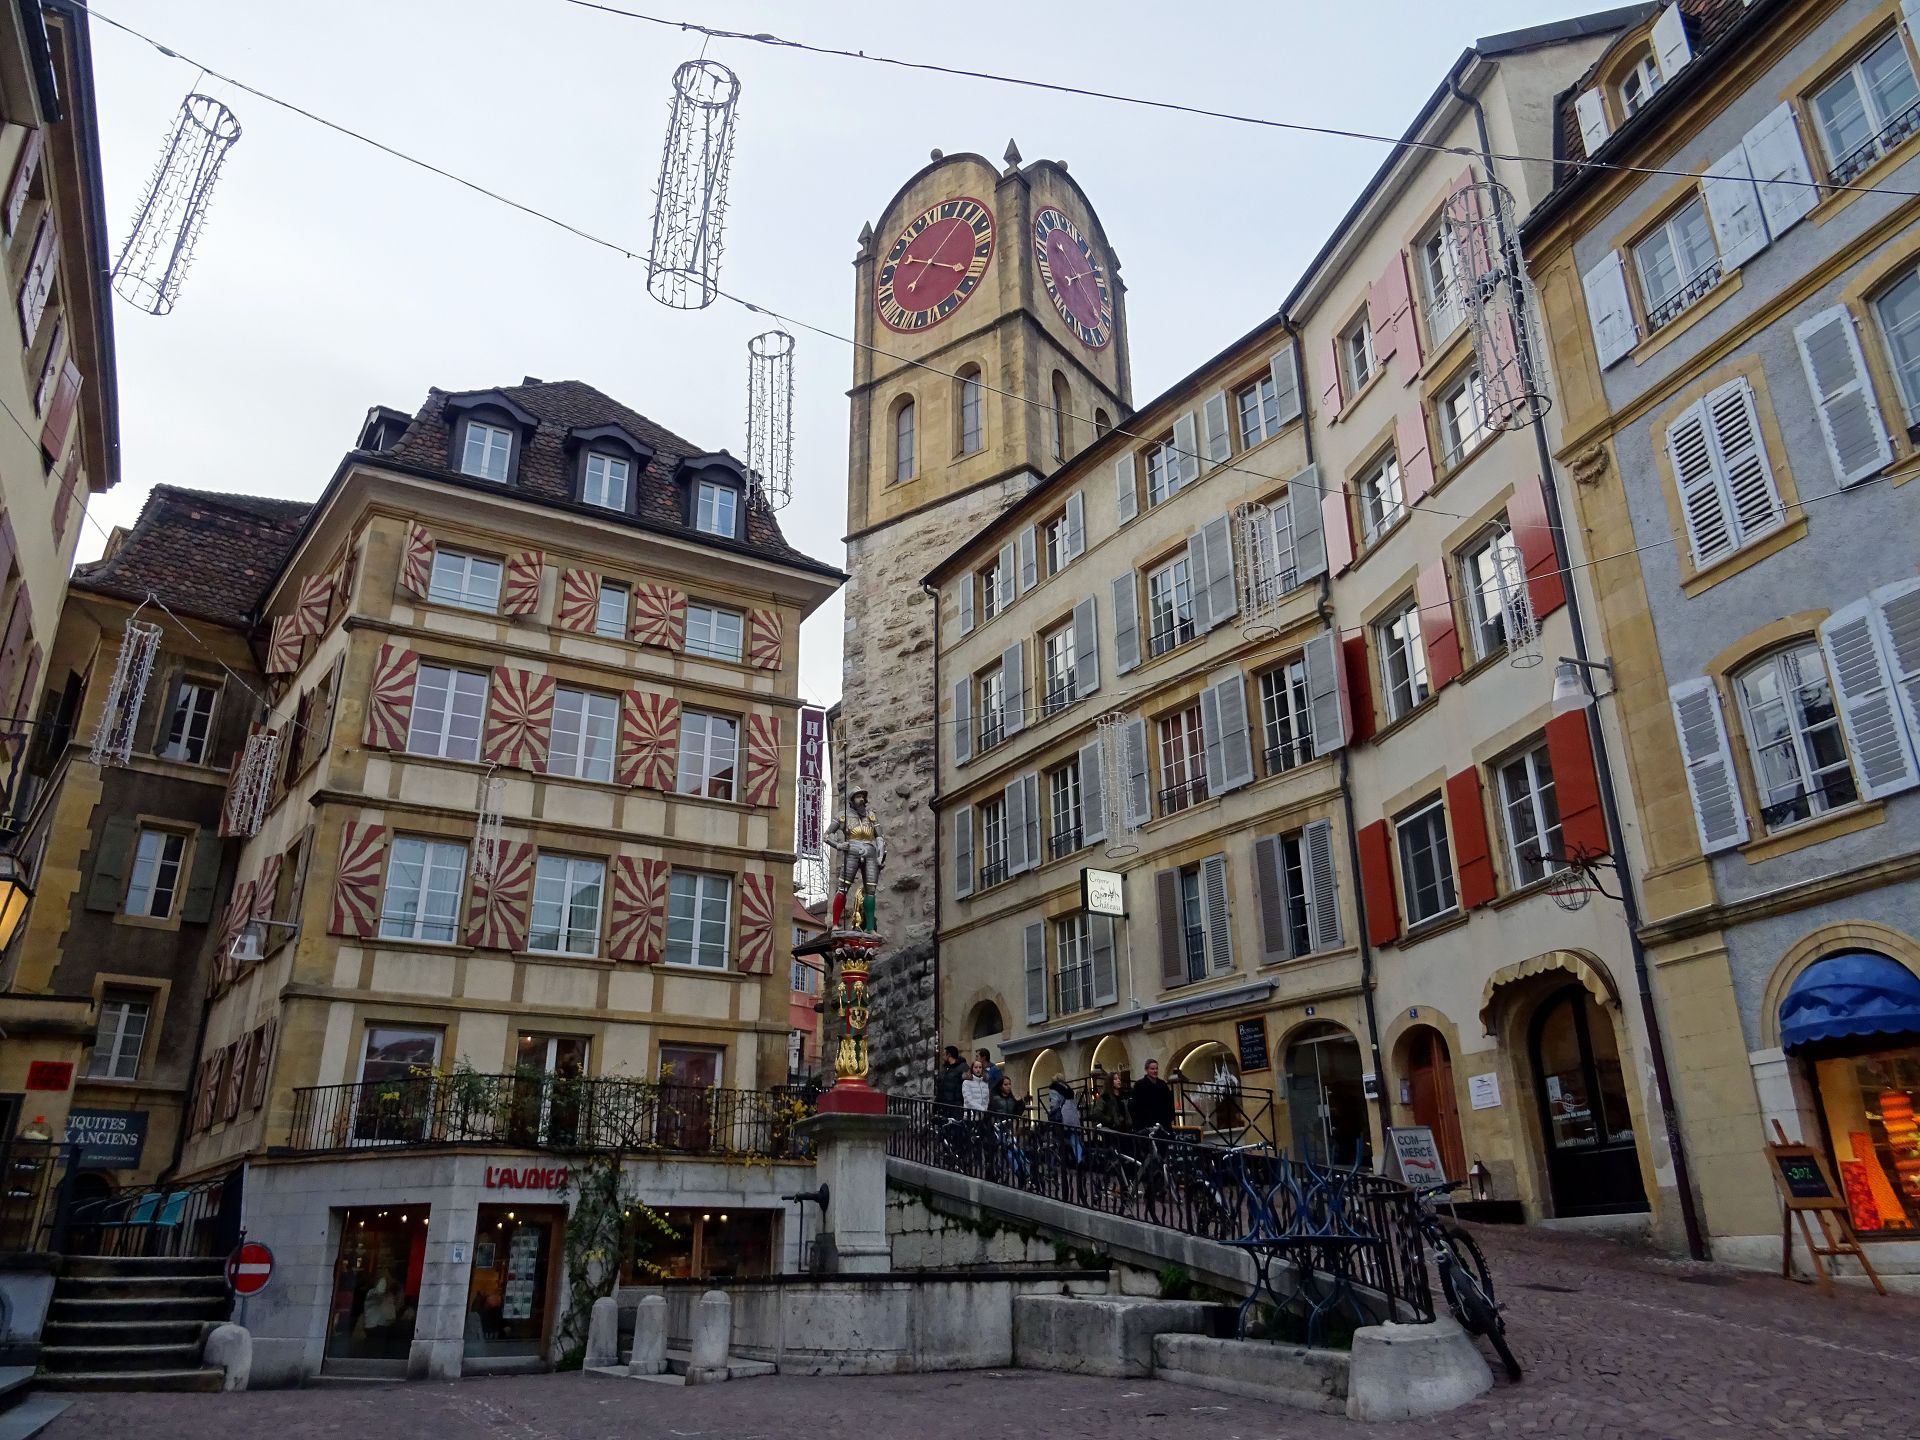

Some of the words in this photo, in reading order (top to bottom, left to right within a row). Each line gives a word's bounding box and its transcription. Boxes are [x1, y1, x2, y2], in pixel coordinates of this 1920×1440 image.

[1090, 890, 1121, 910] Château
[68, 1116, 127, 1130] IQUITES
[75, 1131, 139, 1146] ANCIENS
[1400, 1147, 1432, 1158] MERCE
[1788, 1167, 1812, 1180] -30%
